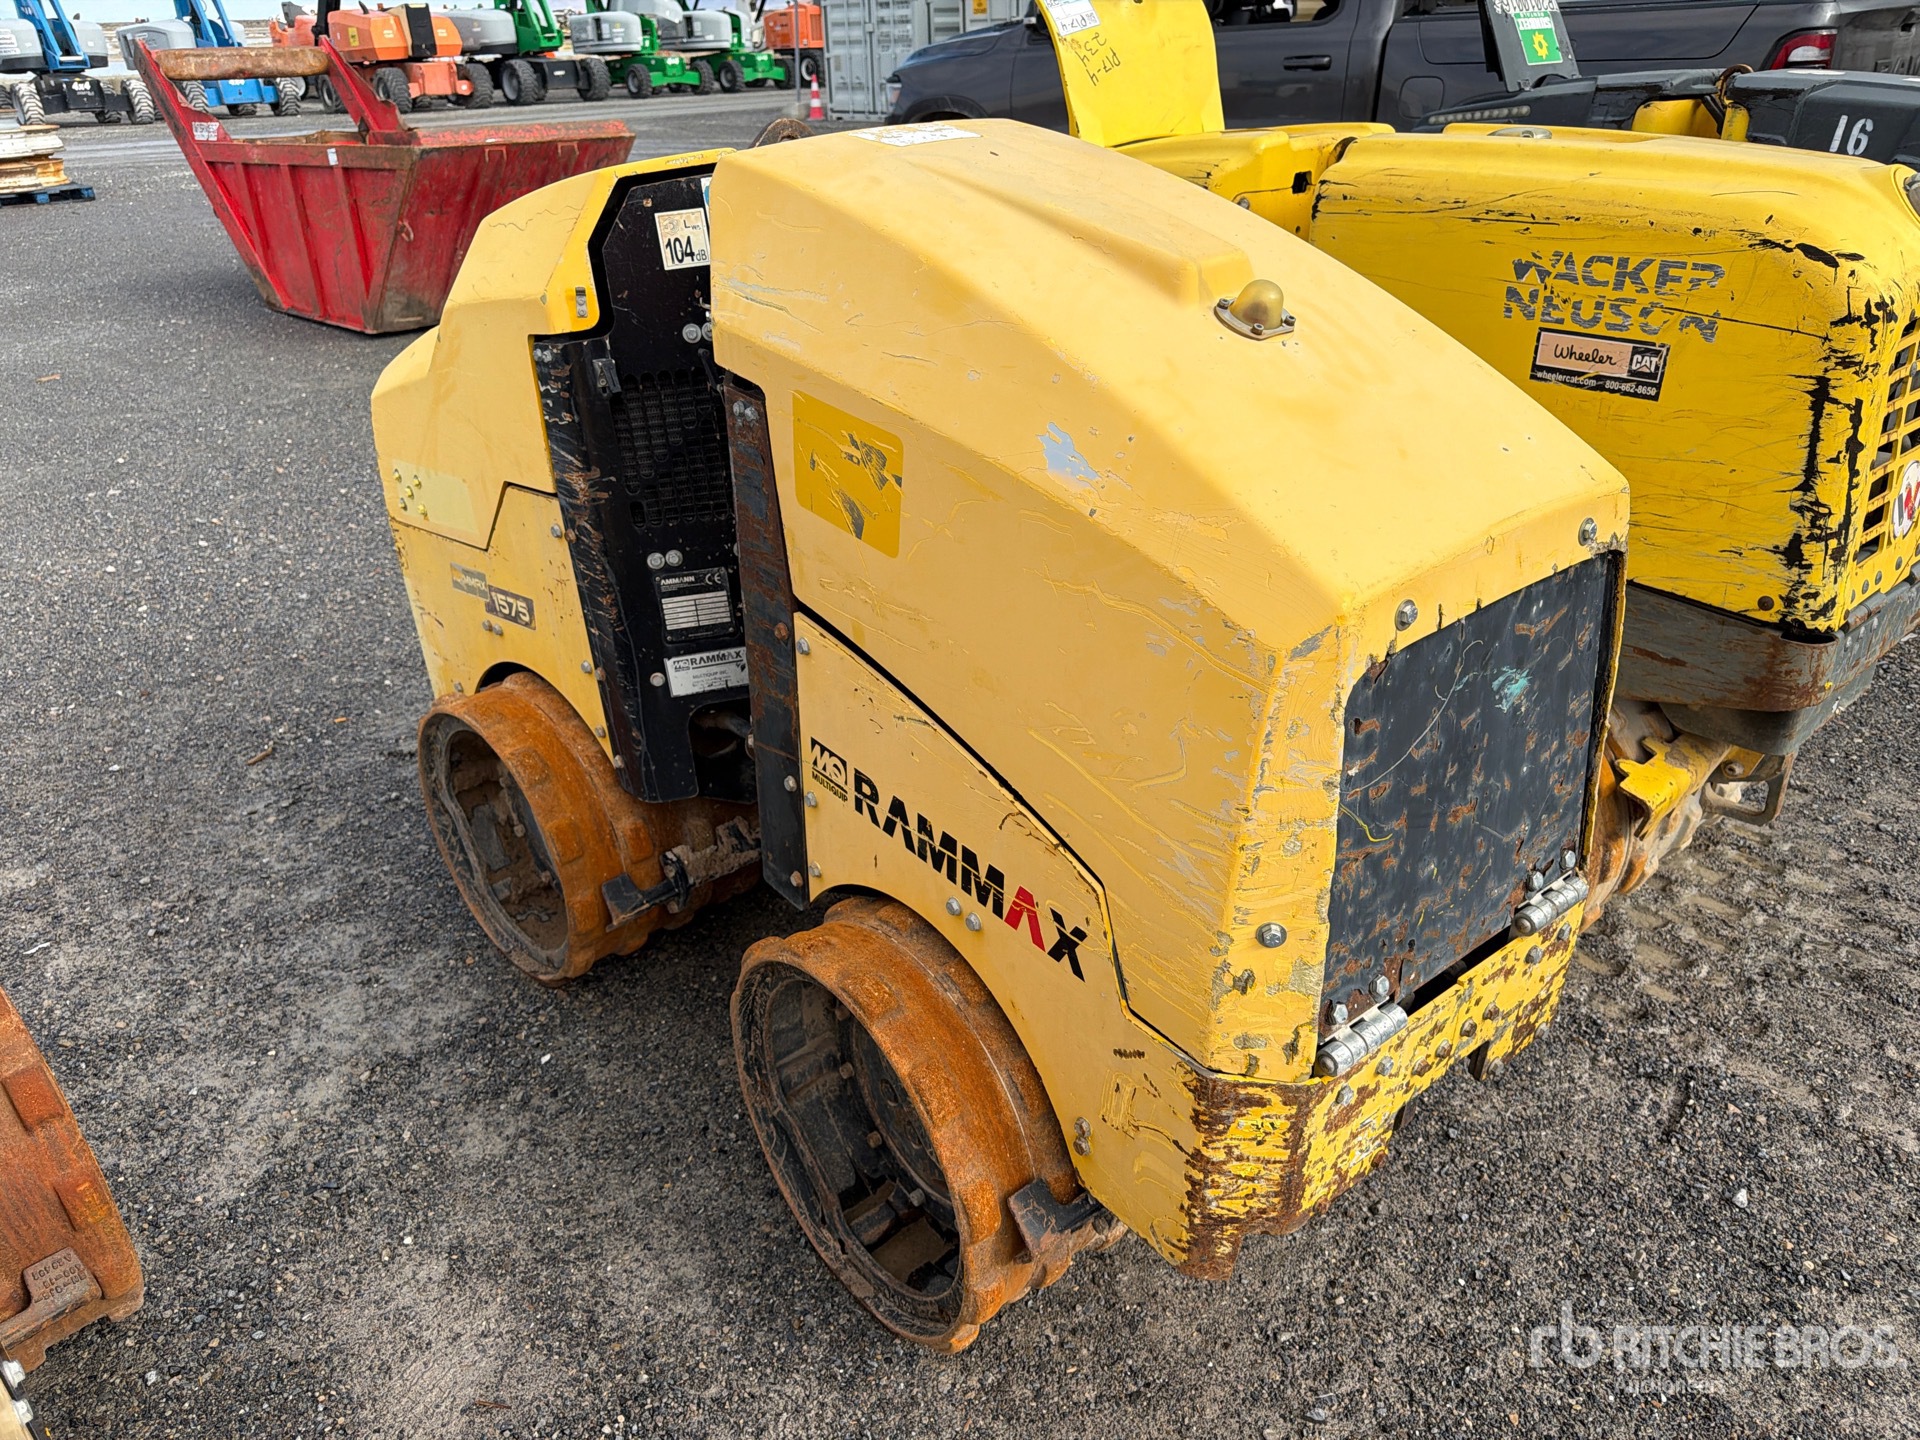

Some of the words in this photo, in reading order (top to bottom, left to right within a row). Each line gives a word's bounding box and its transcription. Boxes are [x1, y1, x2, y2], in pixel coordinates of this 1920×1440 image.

[1074, 31, 1107, 68] 234
[1085, 46, 1121, 87] P17-4
[1829, 114, 1874, 156] 16
[665, 235, 695, 265] 104
[695, 248, 708, 262] dB
[1503, 286, 1722, 343] NEUSON
[1553, 343, 1617, 367] Wheeler
[1631, 353, 1659, 374] CAT
[1536, 370, 1597, 388] wheelercat.com
[1604, 379, 1658, 397] 800-662-8650
[660, 575, 695, 586] AMMANN
[490, 591, 531, 625] 1575
[690, 650, 743, 667] RAMMAX
[811, 770, 848, 803] MULTIQUIP
[854, 767, 1088, 983] RAMMAX
